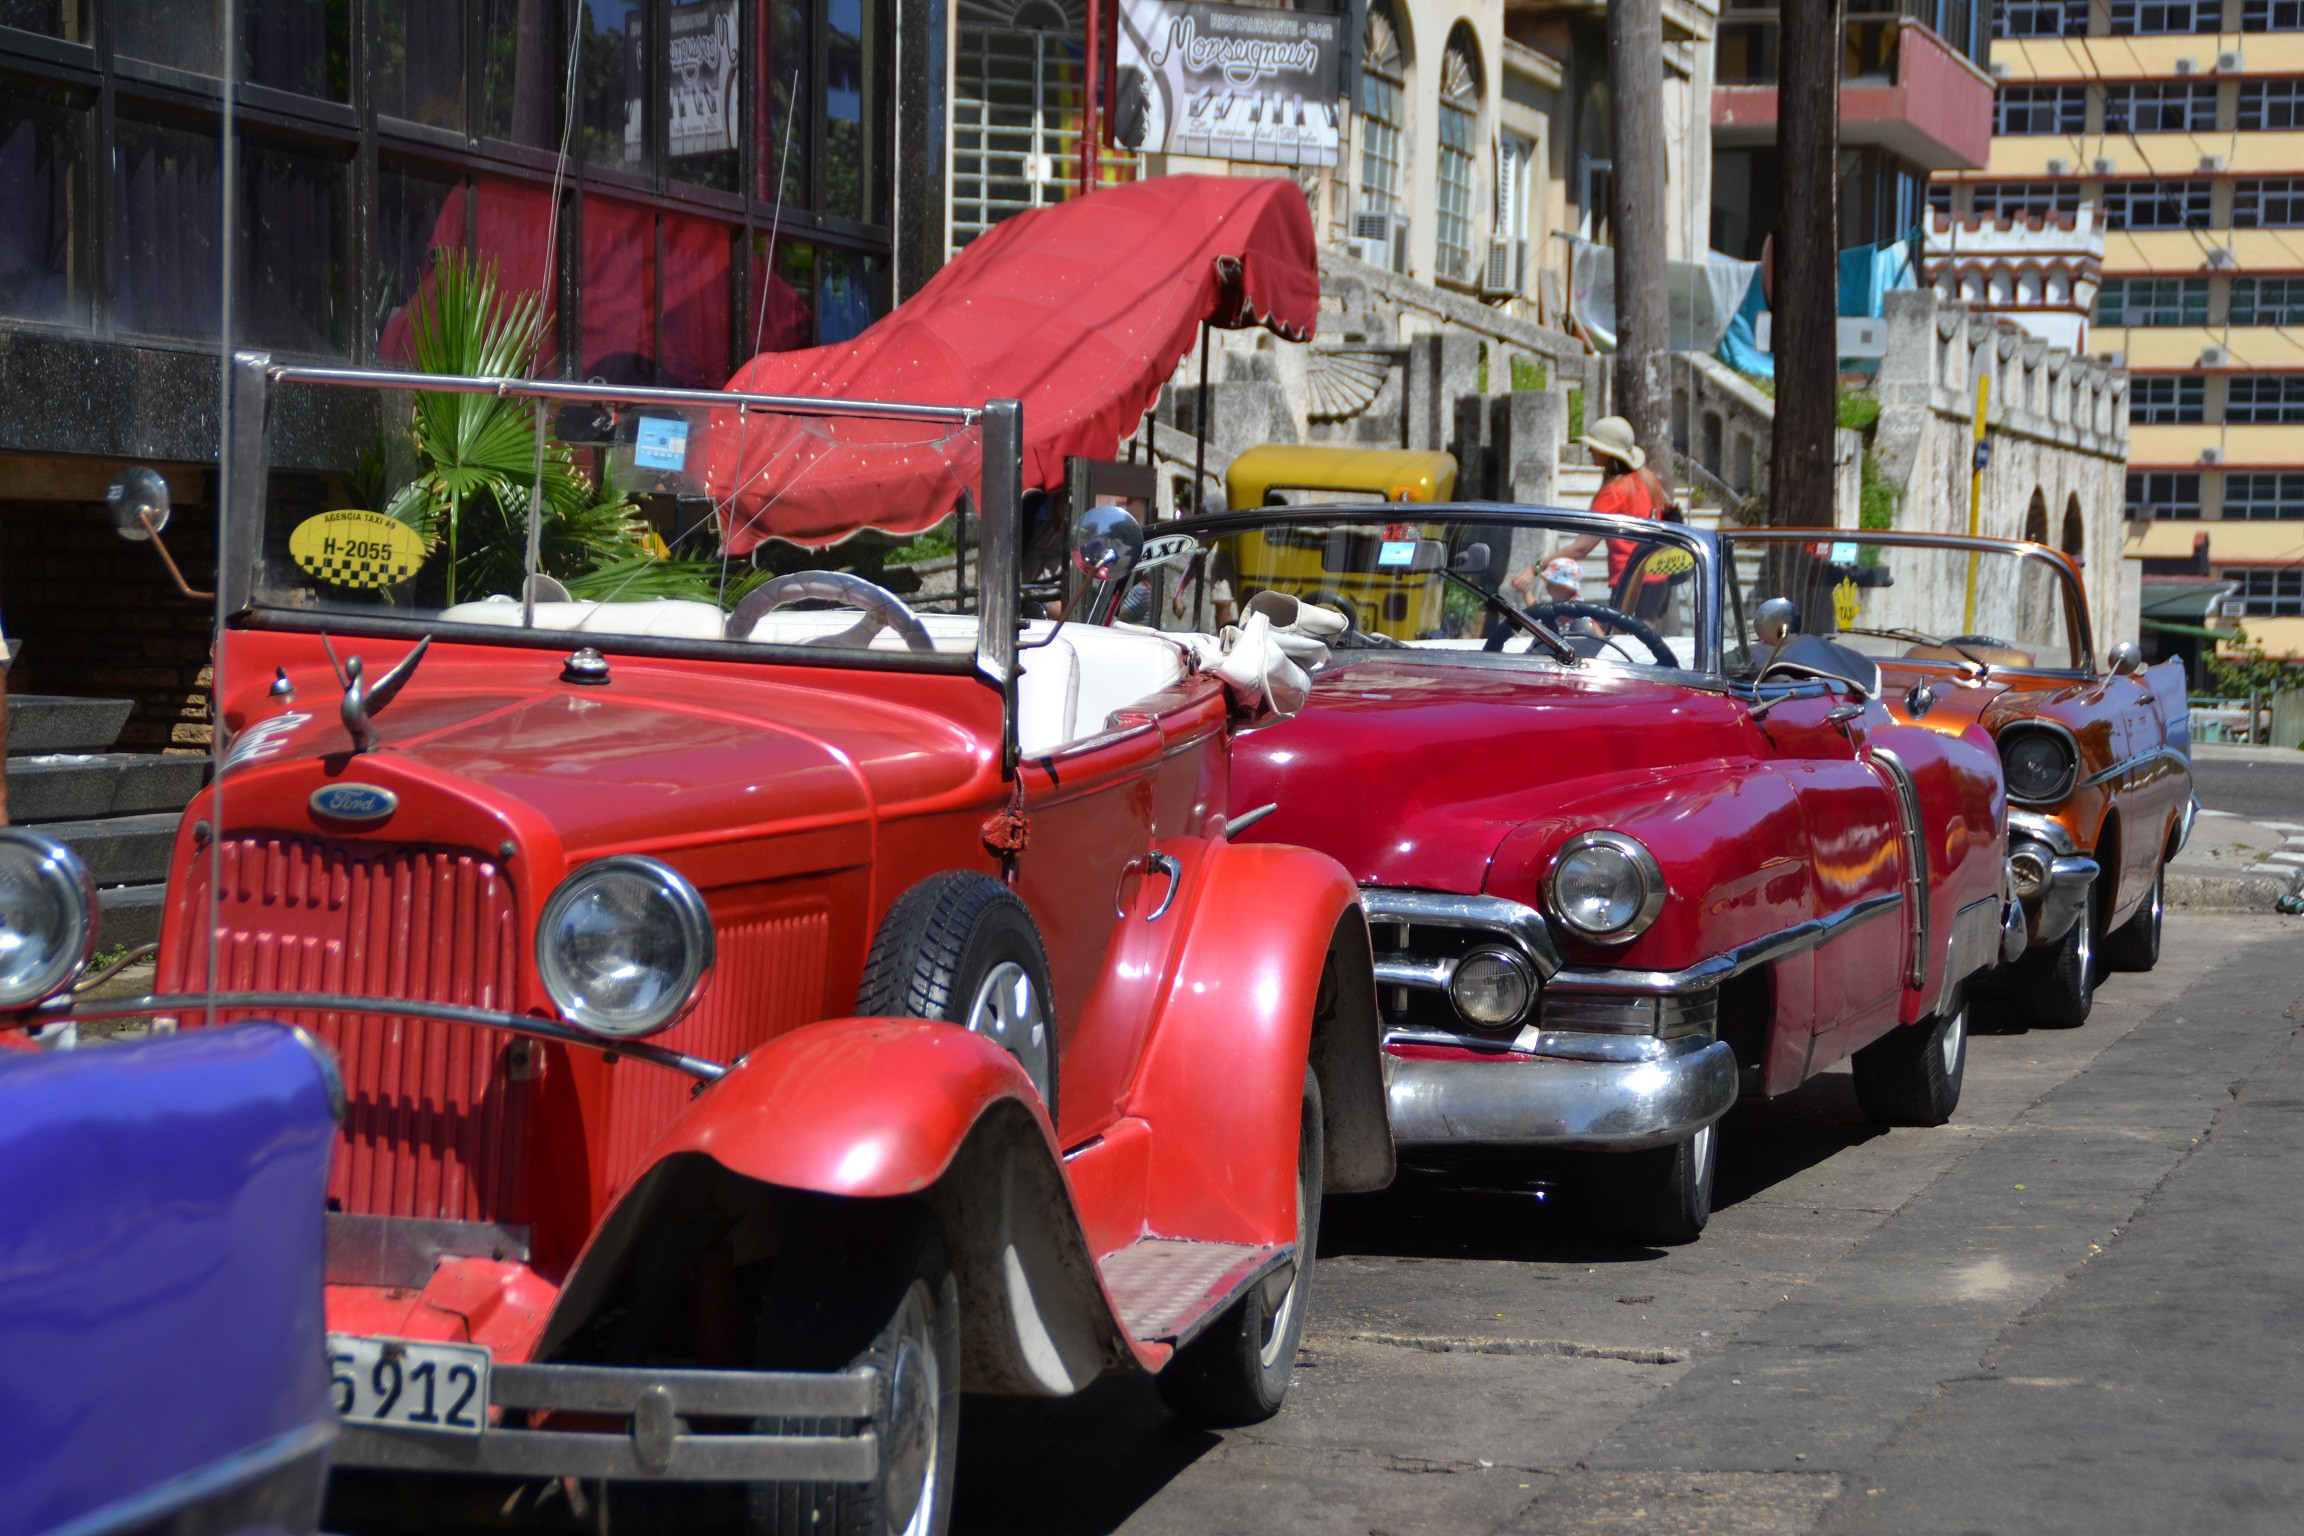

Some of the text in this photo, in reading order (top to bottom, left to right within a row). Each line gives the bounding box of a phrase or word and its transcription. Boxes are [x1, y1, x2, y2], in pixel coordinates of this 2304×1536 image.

[1210, 13, 1334, 40] RESTAURANTE BAR
[1150, 15, 1318, 87] Monseigneur
[324, 512, 396, 530] AGENCIA TAXI #9
[323, 537, 393, 562] H-2055
[1140, 538, 1187, 561] AXI
[329, 790, 375, 811] Ford
